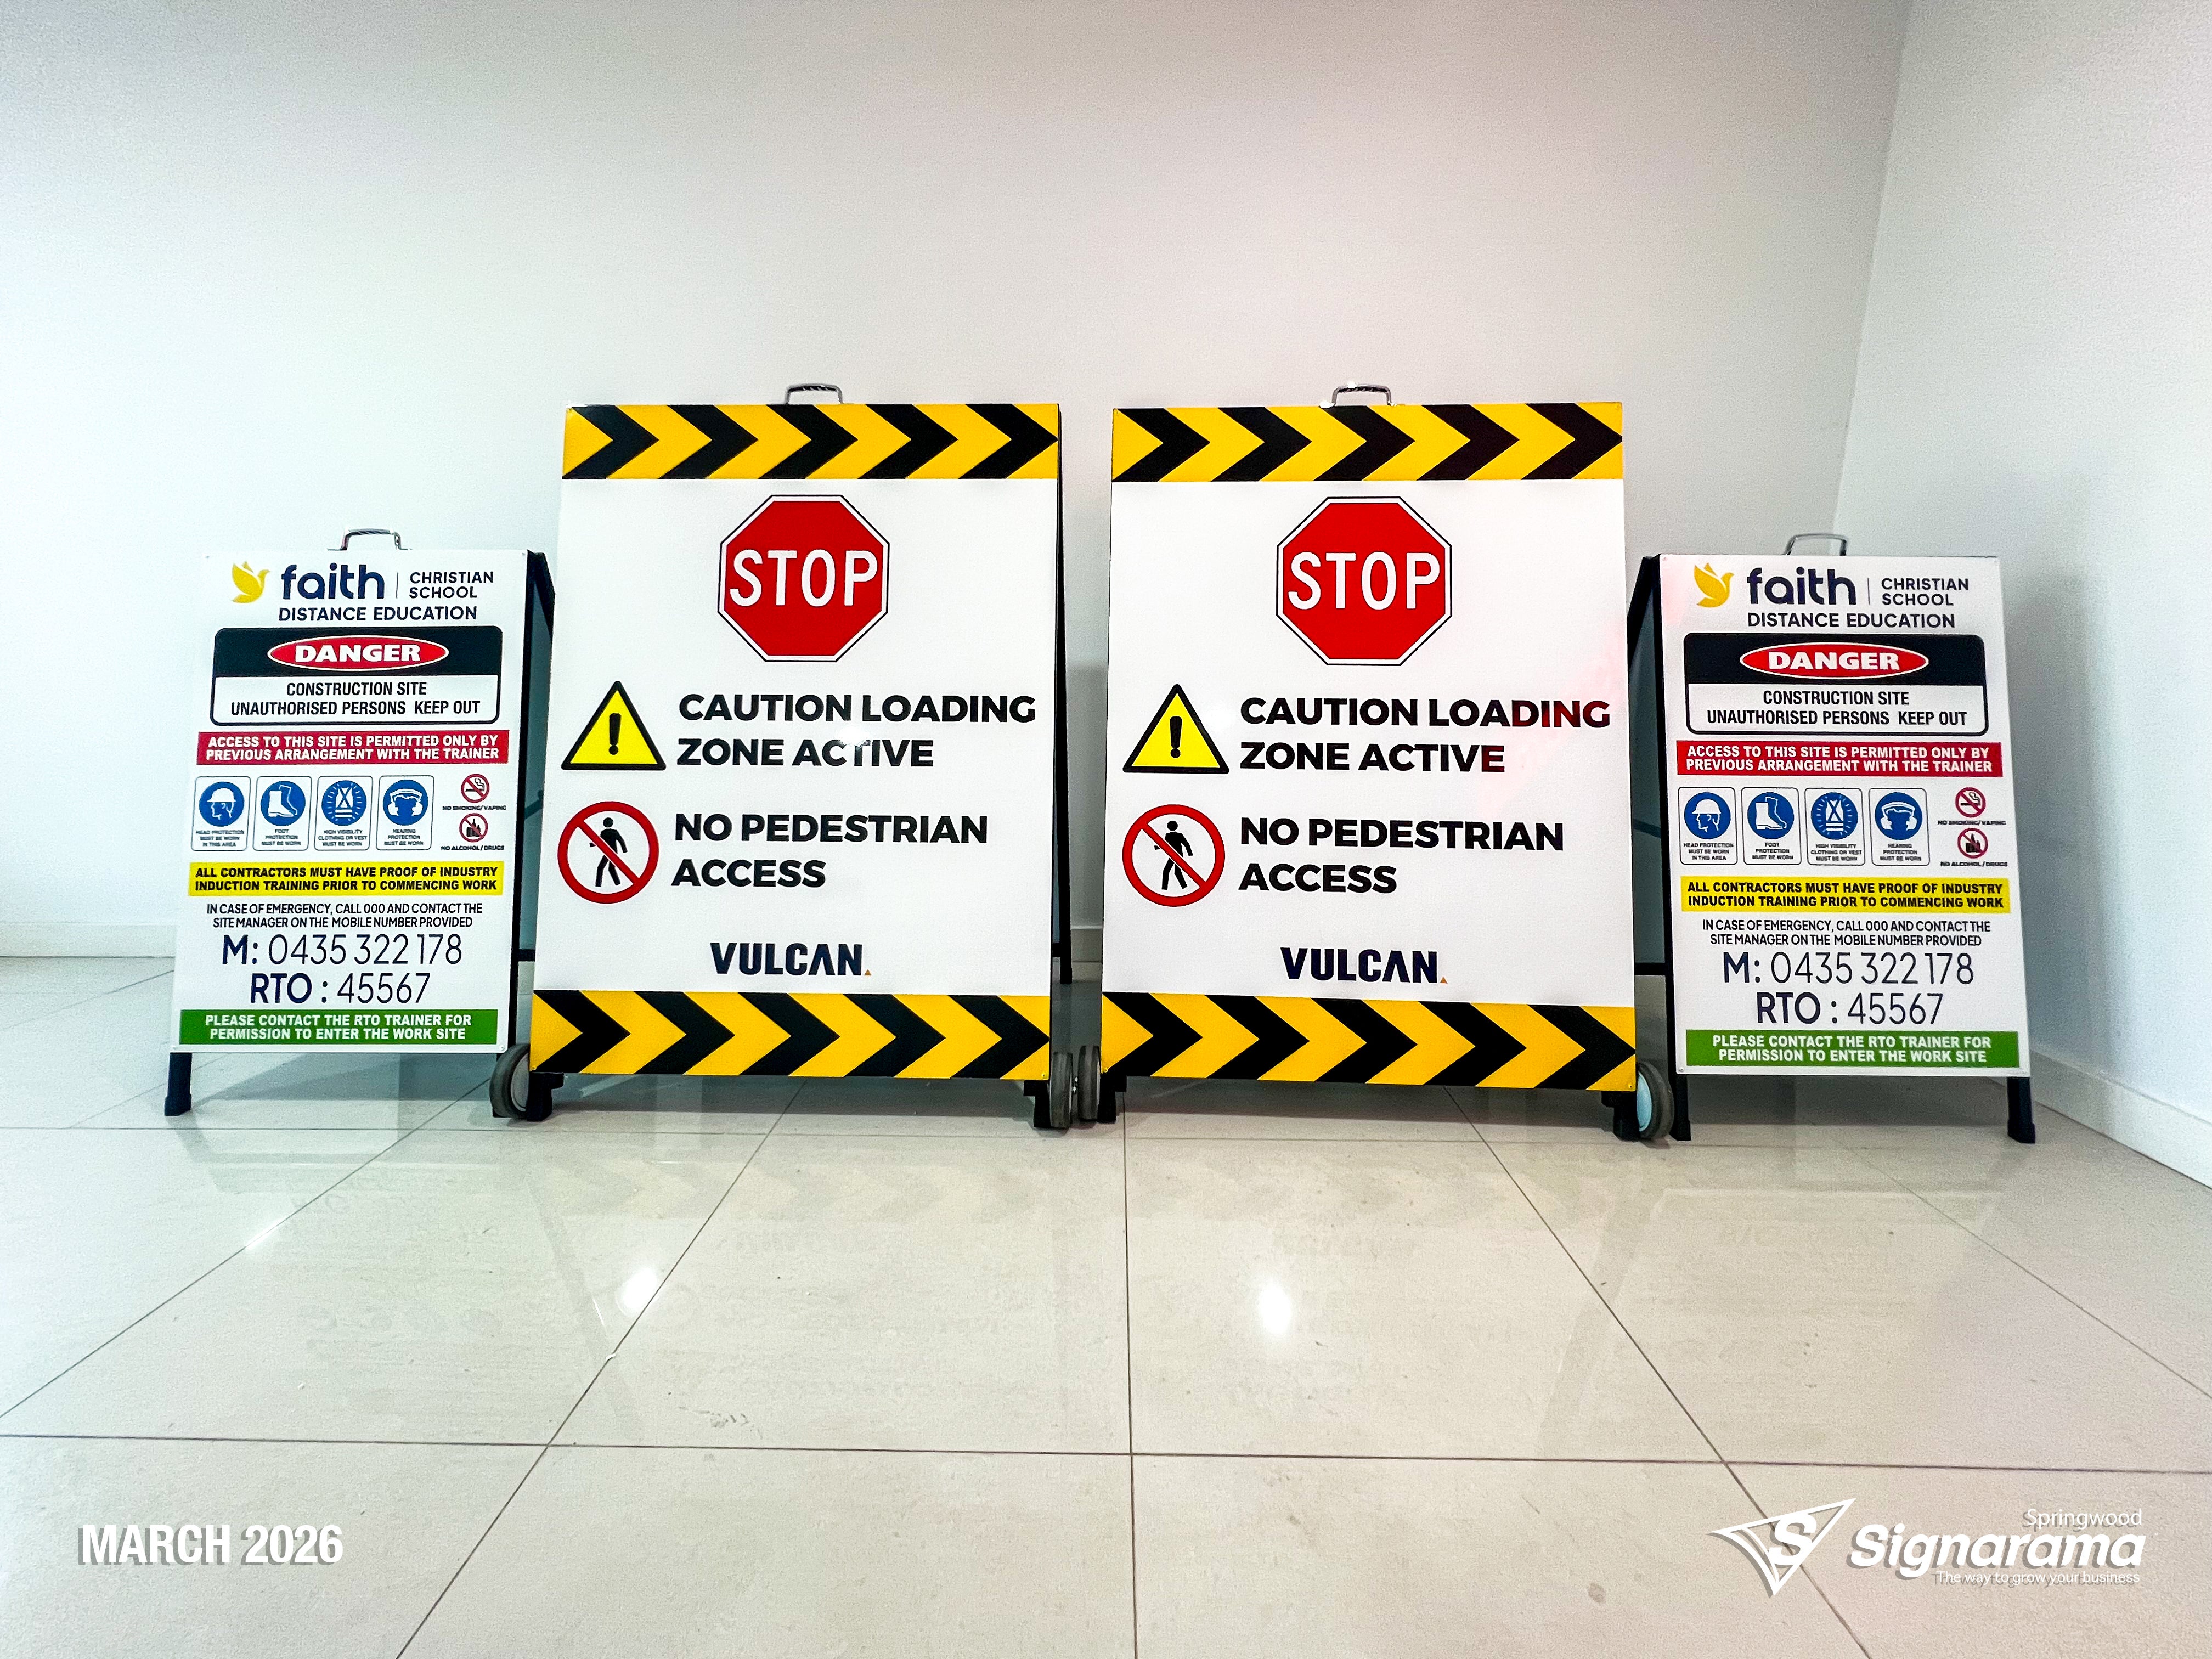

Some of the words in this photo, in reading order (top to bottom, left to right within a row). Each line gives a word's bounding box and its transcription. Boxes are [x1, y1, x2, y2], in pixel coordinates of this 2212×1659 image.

[281, 563, 385, 600] faith
[410, 572, 493, 583] CHRISTIAN
[730, 550, 877, 606] STOP
[1289, 552, 1440, 610] STOP
[1882, 578, 1968, 590] CHRISTIAN
[409, 586, 477, 598] SCHOOL
[1747, 567, 1856, 605] faith
[1882, 593, 1953, 606] SCHOOL
[279, 607, 366, 621] DISTANCE
[374, 606, 477, 620] EDUCATION
[1748, 613, 1839, 627] DISTANCE
[1847, 613, 1955, 628] EDUCATION
[295, 644, 421, 663] DANGER
[1769, 652, 1899, 672] DANGER
[287, 682, 392, 696] CONSTRUCTION
[397, 682, 426, 695] SITE
[1764, 691, 1873, 704] CONSTRUCTION
[1878, 692, 1909, 705] SITE
[232, 702, 337, 715] UNAUTHORISED
[342, 701, 405, 714] PERSONS
[415, 701, 448, 714] KEEP
[454, 701, 480, 714] OUT
[679, 694, 851, 721] CAUTION
[862, 695, 1035, 723] LOADING
[1241, 698, 1418, 725] CAUTION
[1429, 699, 1610, 728] LOADING
[1708, 710, 1817, 724] UNAUTHORISED
[1823, 711, 1889, 724] PERSONS
[1899, 711, 1934, 725] KEEP
[1939, 712, 1967, 725] OUT
[208, 737, 259, 747] ACCESS
[263, 736, 279, 747] TO
[284, 736, 313, 747] THIS
[318, 736, 346, 747] SITE
[351, 736, 362, 746] IS
[366, 736, 439, 746] PERMITTED
[443, 735, 477, 746] ONLY
[481, 735, 498, 746] BY
[206, 749, 271, 760] PREVIOUS
[275, 749, 373, 760] ARRANGEMENT
[377, 749, 409, 759] WITH
[414, 748, 439, 759] THE
[443, 748, 499, 759] TRAINER
[677, 738, 784, 765] ZONE
[1240, 742, 1349, 770] ZONE
[1358, 744, 1504, 772] ACTIVE
[1688, 746, 1739, 757] ACCESS
[1743, 746, 1761, 757] TO
[1765, 746, 1796, 757] THIS
[1801, 747, 1830, 757] SITE
[1835, 747, 1847, 757] IS
[1852, 747, 1927, 758] PERMITTED
[1932, 747, 1966, 758] ONLY
[1972, 748, 1989, 758] BY
[1686, 759, 1753, 770] PREVIOUS
[1758, 760, 1859, 771] ARRANGEMENT
[1864, 760, 1898, 771] WITH
[1902, 760, 1929, 771] THE
[1933, 761, 1991, 772] TRAINER
[675, 814, 732, 841] NO
[742, 814, 987, 843] PEDESTRIAN
[1242, 817, 1299, 845] NO
[1309, 819, 1563, 850] PEDESTRIAN
[196, 868, 217, 877] ALL
[221, 868, 306, 877] CONTRACTORS
[310, 867, 342, 877] MUST
[346, 867, 376, 877] HAVE
[380, 867, 417, 877] PROOF
[422, 867, 436, 876] OF
[441, 867, 498, 877] INDUSTRY
[672, 859, 826, 888] ACCESS
[1239, 864, 1396, 893] ACCESS
[196, 881, 259, 890] INDUCTION
[263, 881, 319, 890] TRAINING
[323, 881, 357, 890] PRIOR
[362, 881, 376, 890] TO
[380, 881, 459, 890] COMMENCING
[463, 880, 496, 890] WORK
[1703, 919, 1713, 930] IN
[1716, 920, 1744, 930] CASE
[1747, 920, 1762, 930] OF
[1764, 920, 1833, 932] EMERGENCY,
[1837, 921, 1864, 931] CALL
[1866, 921, 1888, 931] 000
[1891, 921, 1914, 931] AND
[1916, 921, 1968, 932] CONTACT
[1970, 921, 1990, 932] THE
[1711, 934, 1733, 944] SITE
[1735, 934, 1788, 945] MANAGER
[1791, 934, 1808, 945] ON
[1810, 935, 1830, 945] THE
[1835, 935, 1876, 945] MOBILE
[1878, 935, 1923, 945] NUMBER
[1926, 935, 1981, 946] PROVIDED
[223, 935, 258, 964] M:
[269, 934, 346, 964] 0435
[354, 934, 408, 964] 322
[417, 934, 461, 964] 178
[1724, 952, 1760, 983] M:
[1771, 952, 1852, 984] 0435
[1861, 952, 1918, 984] 322
[1925, 953, 1973, 984] 178
[251, 973, 312, 1003] RTO
[337, 973, 430, 1003] 45567
[1757, 992, 1820, 1024] RTO
[1848, 993, 1943, 1024] 45567
[206, 1015, 255, 1025] PLEASE
[259, 1015, 320, 1025] CONTACT
[324, 1015, 350, 1025] THE
[354, 1015, 380, 1025] RTO
[385, 1015, 441, 1025] TRAINER
[446, 1015, 471, 1025] FOR
[211, 1028, 290, 1039] PERMISSION
[295, 1029, 311, 1039] TO
[316, 1029, 359, 1039] ENTER
[363, 1028, 388, 1039] THE
[393, 1028, 432, 1039] WORK
[436, 1028, 465, 1039] SITE
